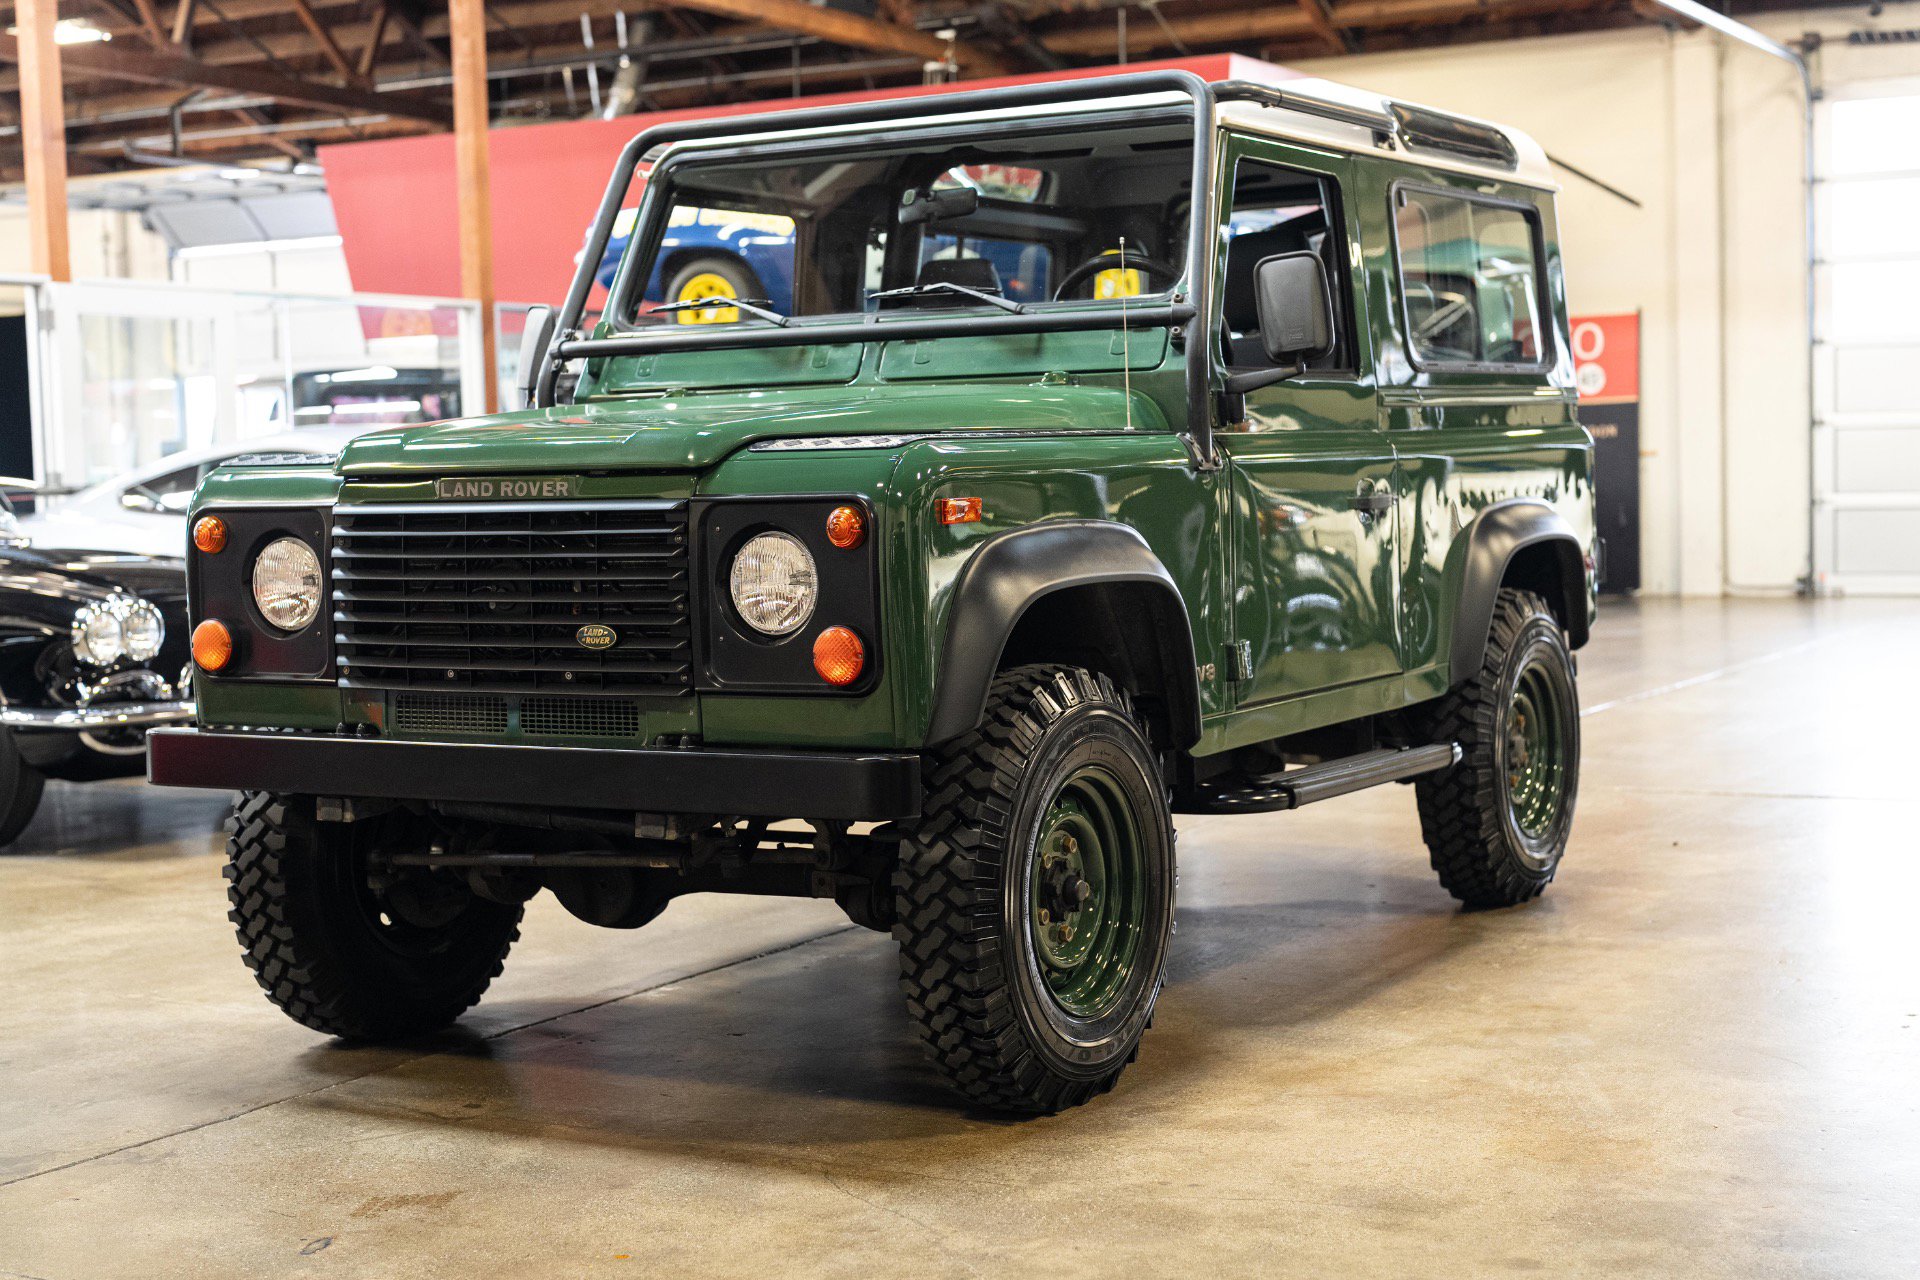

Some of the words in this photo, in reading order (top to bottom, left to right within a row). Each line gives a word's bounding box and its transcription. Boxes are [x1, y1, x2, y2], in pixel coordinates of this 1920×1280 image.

[440, 482, 493, 497] LAND
[500, 481, 569, 497] ROVER
[1197, 663, 1215, 682] V8
